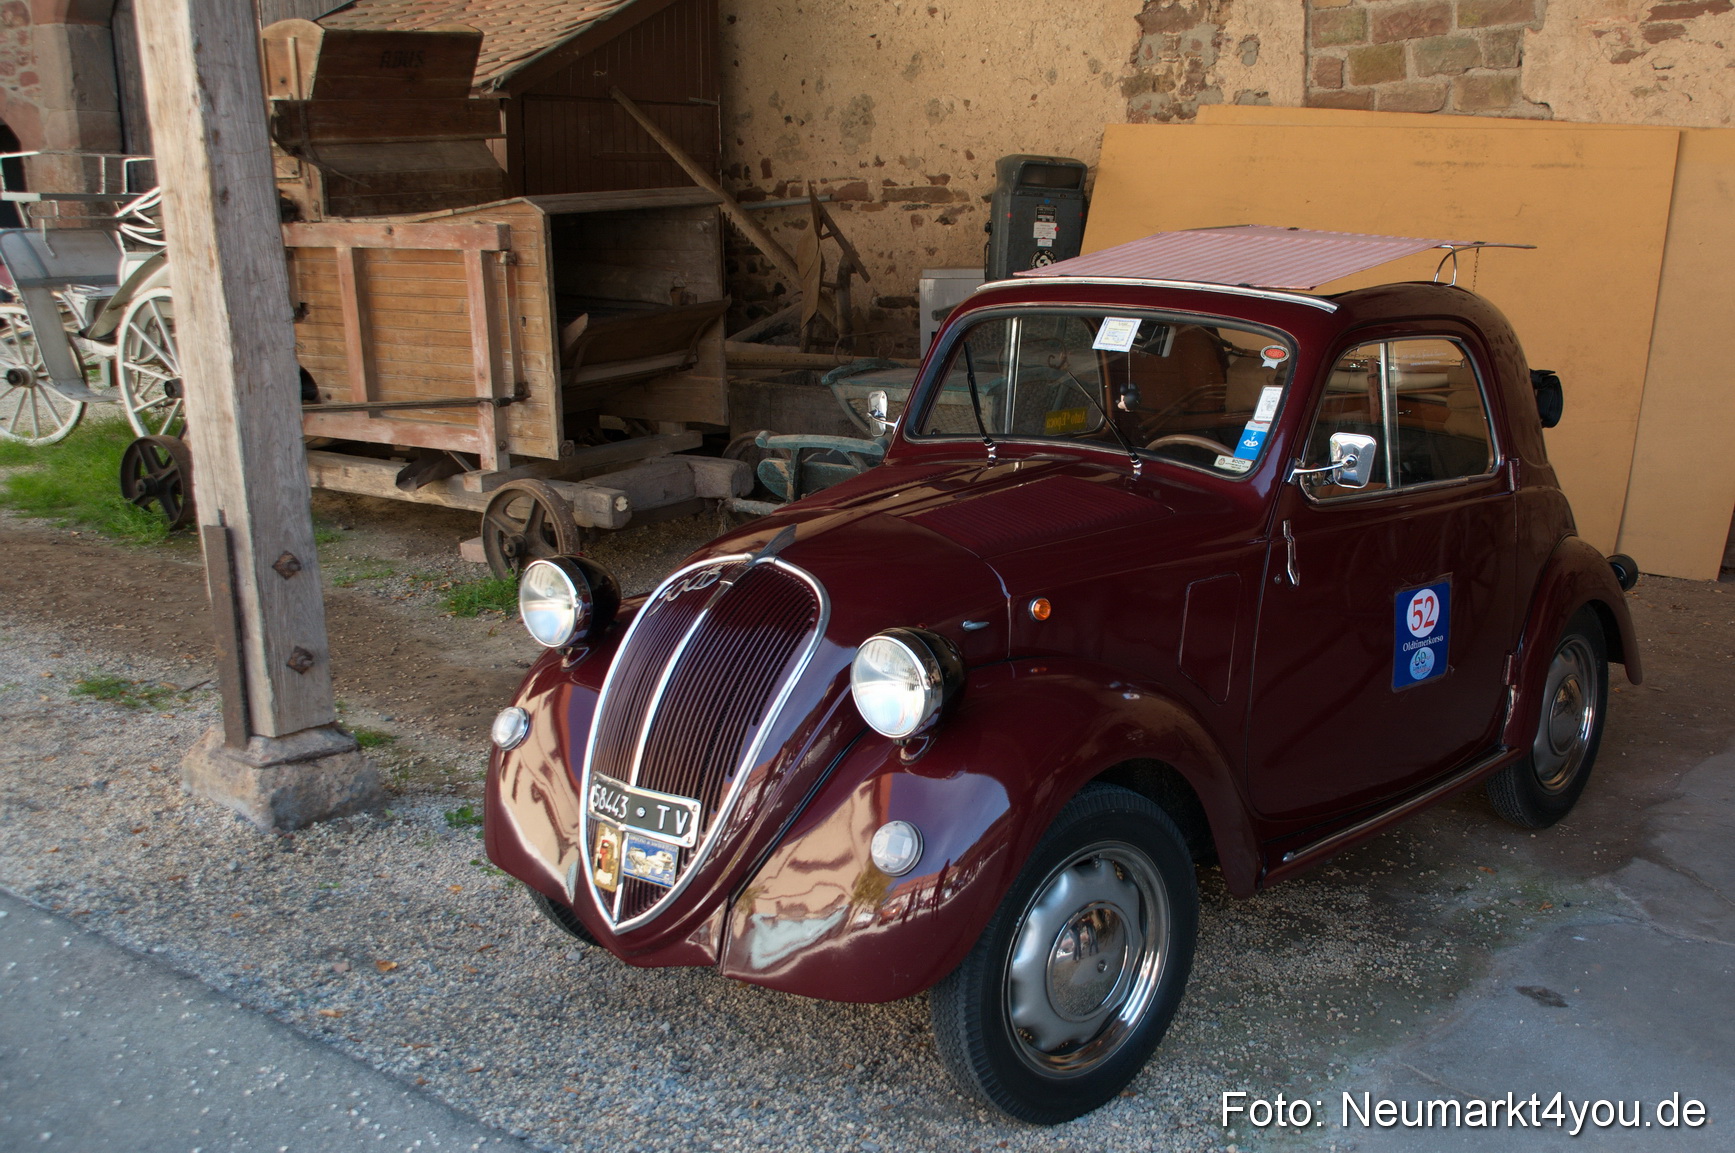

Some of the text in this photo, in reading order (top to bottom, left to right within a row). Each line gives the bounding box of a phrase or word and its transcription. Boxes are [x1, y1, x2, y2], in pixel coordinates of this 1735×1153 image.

[1411, 596, 1435, 631] 52
[1402, 634, 1444, 652] Oldtimerkorso
[593, 784, 629, 819] 58443
